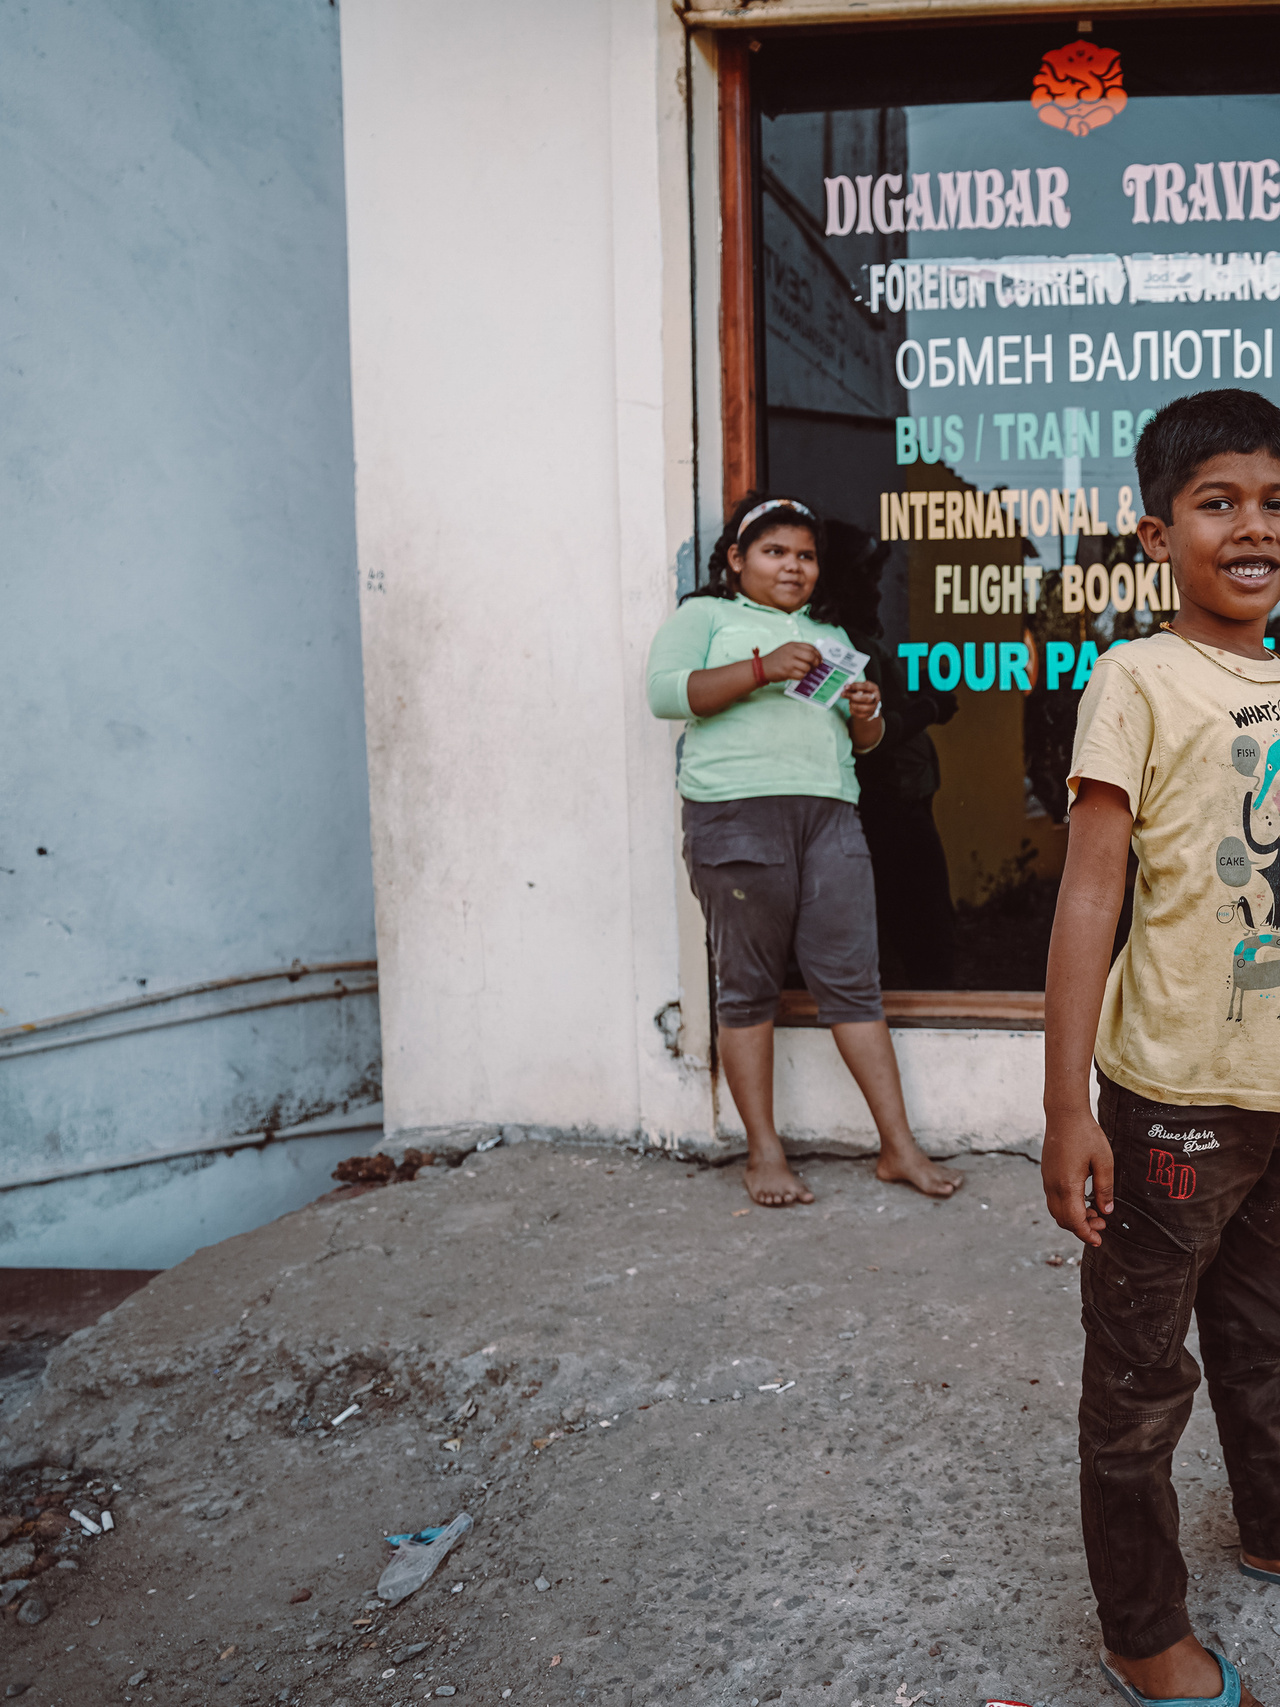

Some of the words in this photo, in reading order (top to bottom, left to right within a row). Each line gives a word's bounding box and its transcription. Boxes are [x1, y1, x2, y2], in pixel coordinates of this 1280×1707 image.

[824, 166, 1071, 237] DIGAMBAR
[870, 263, 987, 314] FOREIGN
[896, 334, 1054, 390] ОБМЕН
[1069, 328, 1274, 384] ВАЛЮТЫ
[896, 414, 965, 465] BUS
[992, 407, 1100, 461] TRAIN
[881, 487, 1109, 541] INTERNATIONAL
[935, 565, 1043, 614] FLIGHT
[899, 642, 1031, 692] TOUR
[1229, 701, 1280, 729] WHAT'S
[1237, 748, 1256, 758] FISH
[1219, 856, 1245, 866] CAKE
